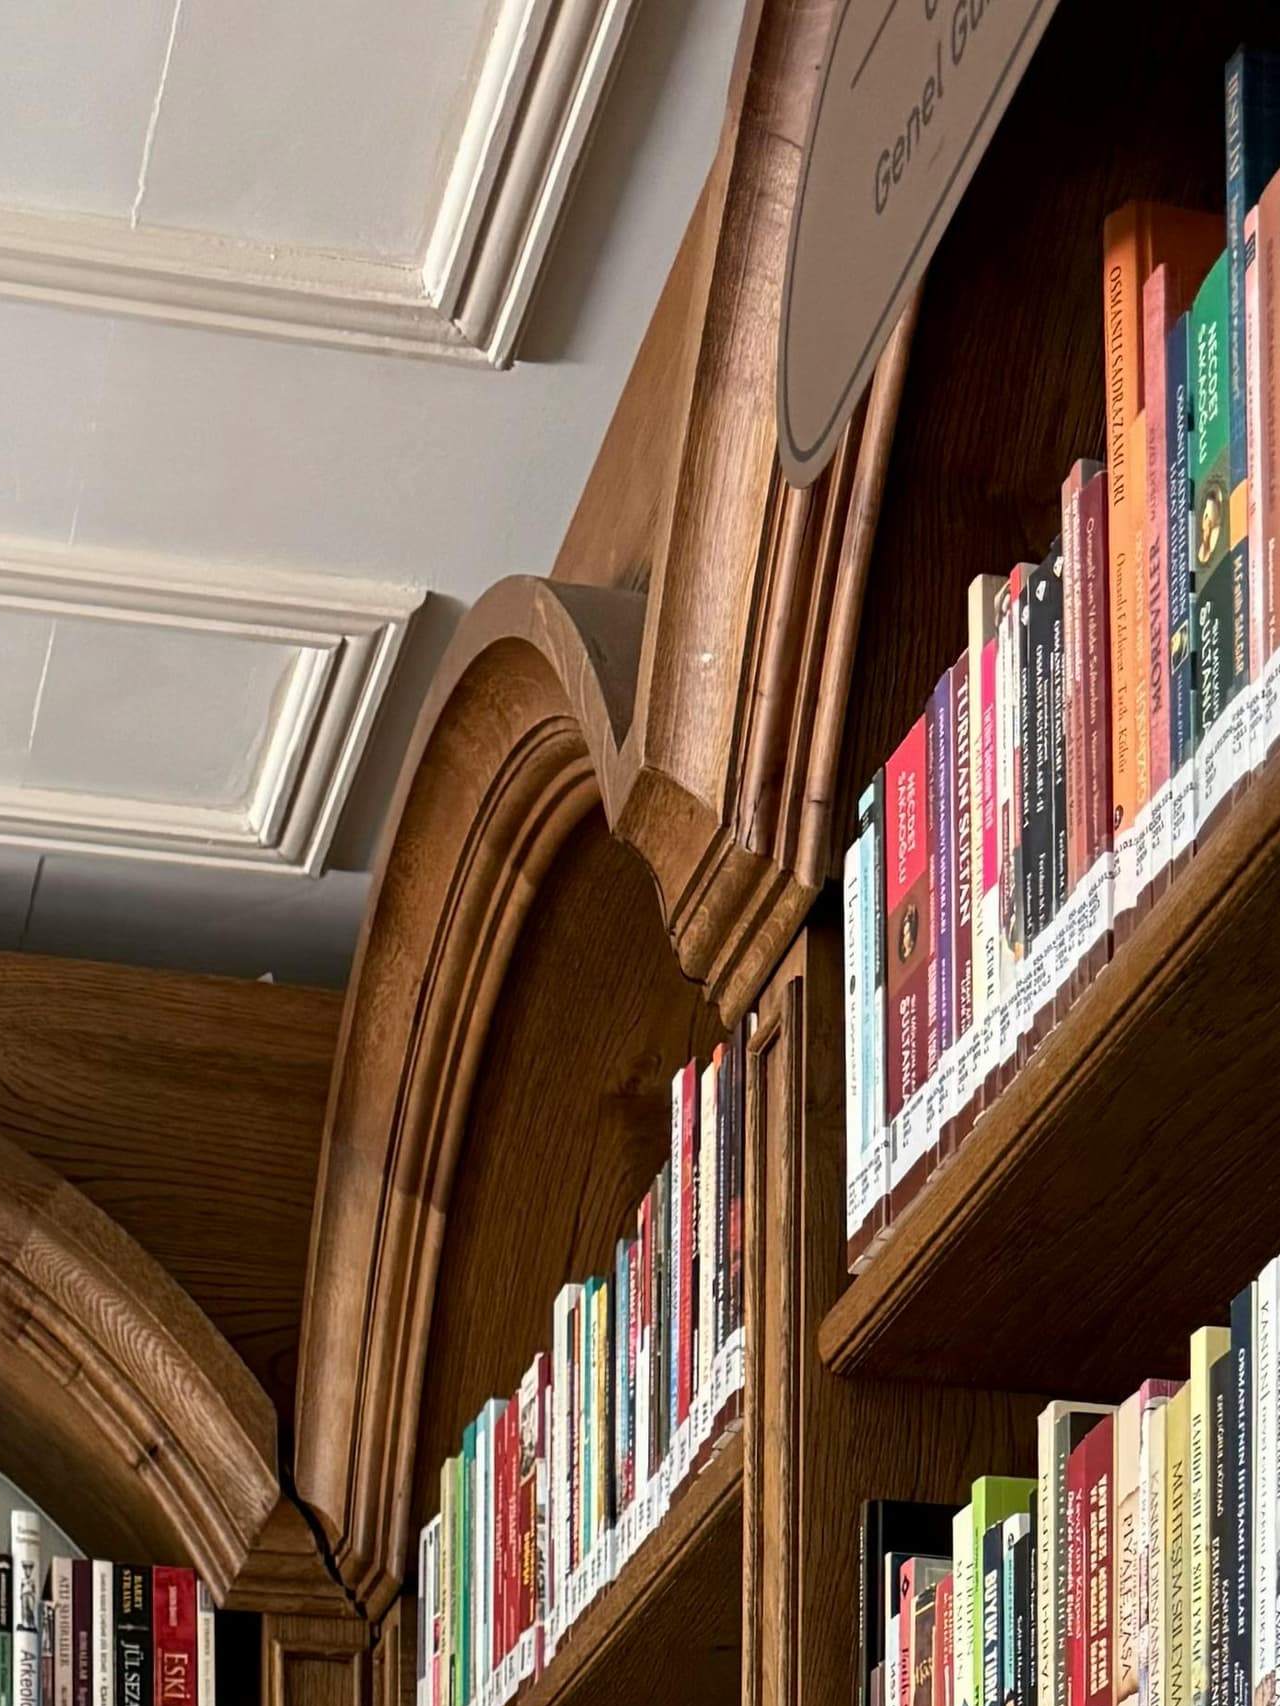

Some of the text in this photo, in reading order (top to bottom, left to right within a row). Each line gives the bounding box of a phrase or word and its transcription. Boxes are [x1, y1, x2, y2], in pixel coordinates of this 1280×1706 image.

[875, 42, 944, 217] Genel
[957, 673, 970, 928] TURHAN SULTAN
[162, 1651, 188, 1699] ESKİ
